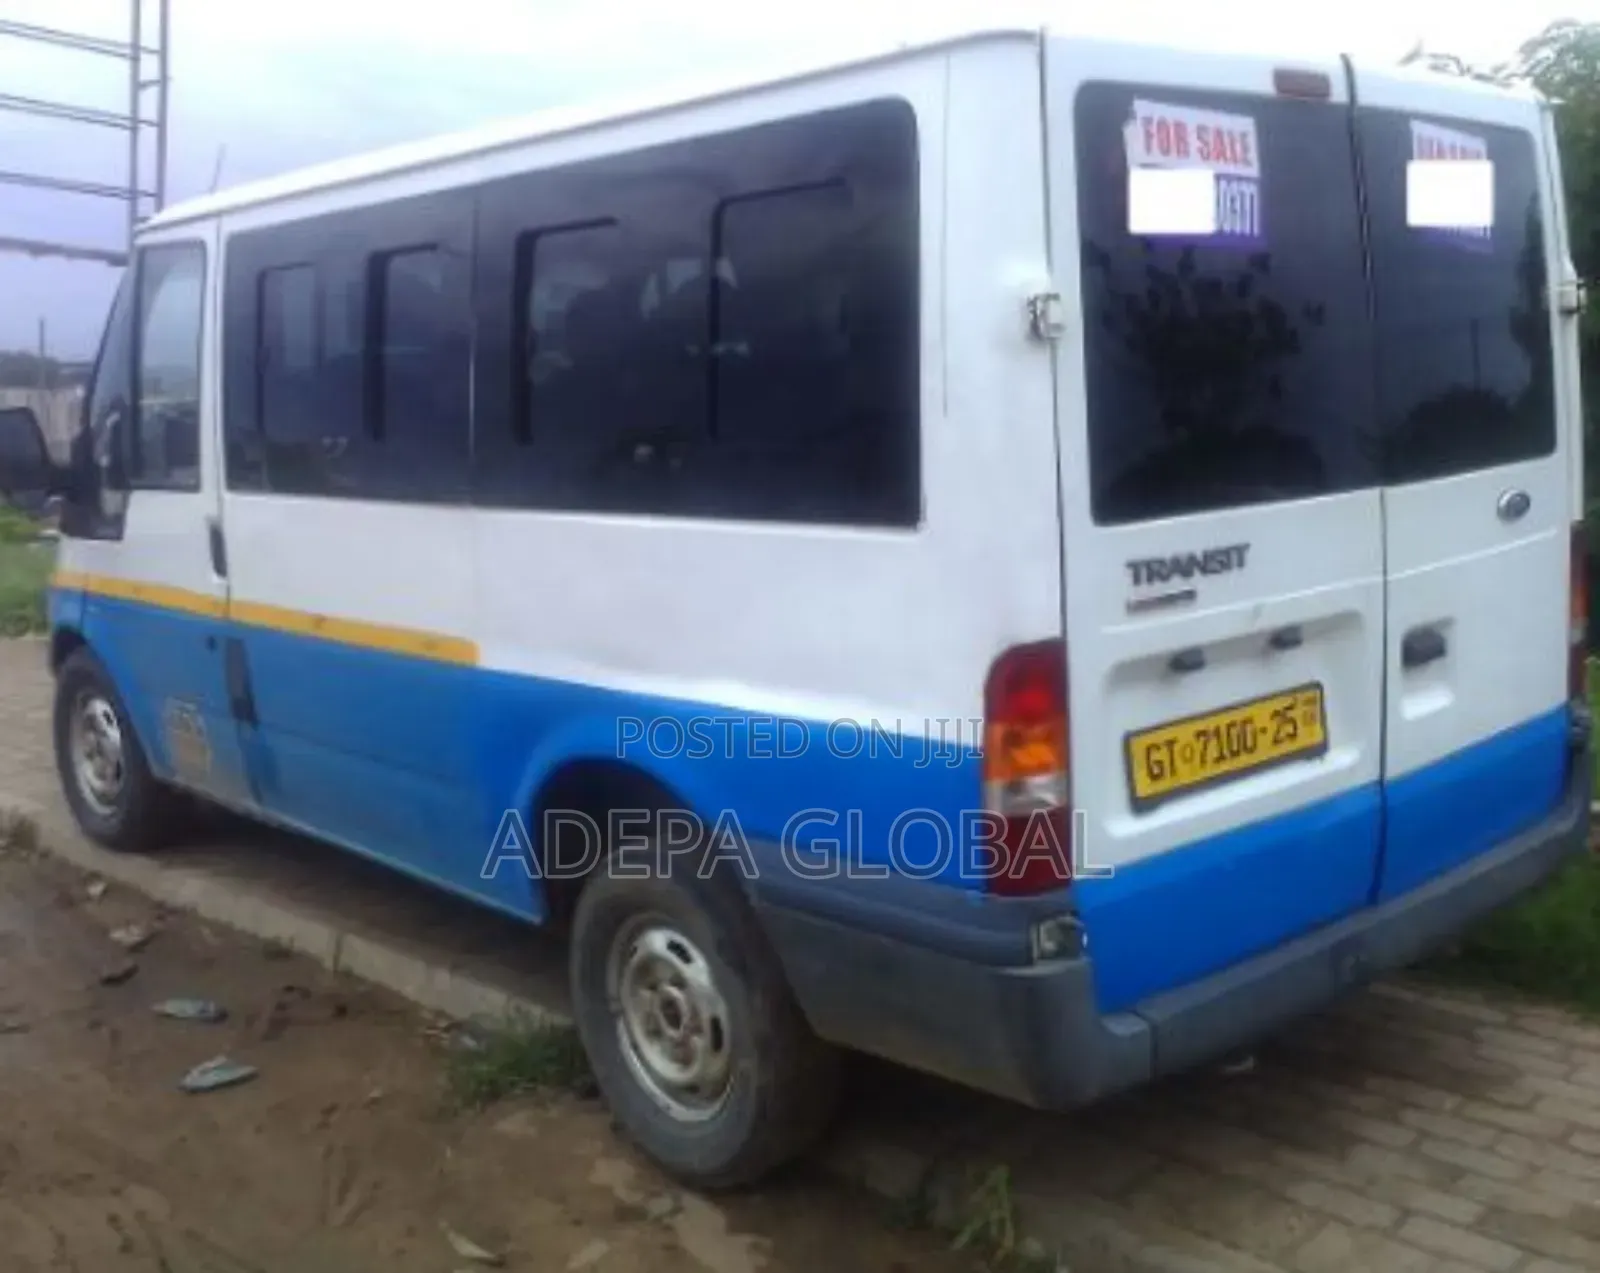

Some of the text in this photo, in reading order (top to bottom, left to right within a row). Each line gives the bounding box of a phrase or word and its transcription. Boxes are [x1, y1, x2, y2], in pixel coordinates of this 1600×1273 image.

[1141, 115, 1254, 169] FOR SALE
[1125, 542, 1251, 586] TRANSIT
[1144, 736, 1179, 782] GT
